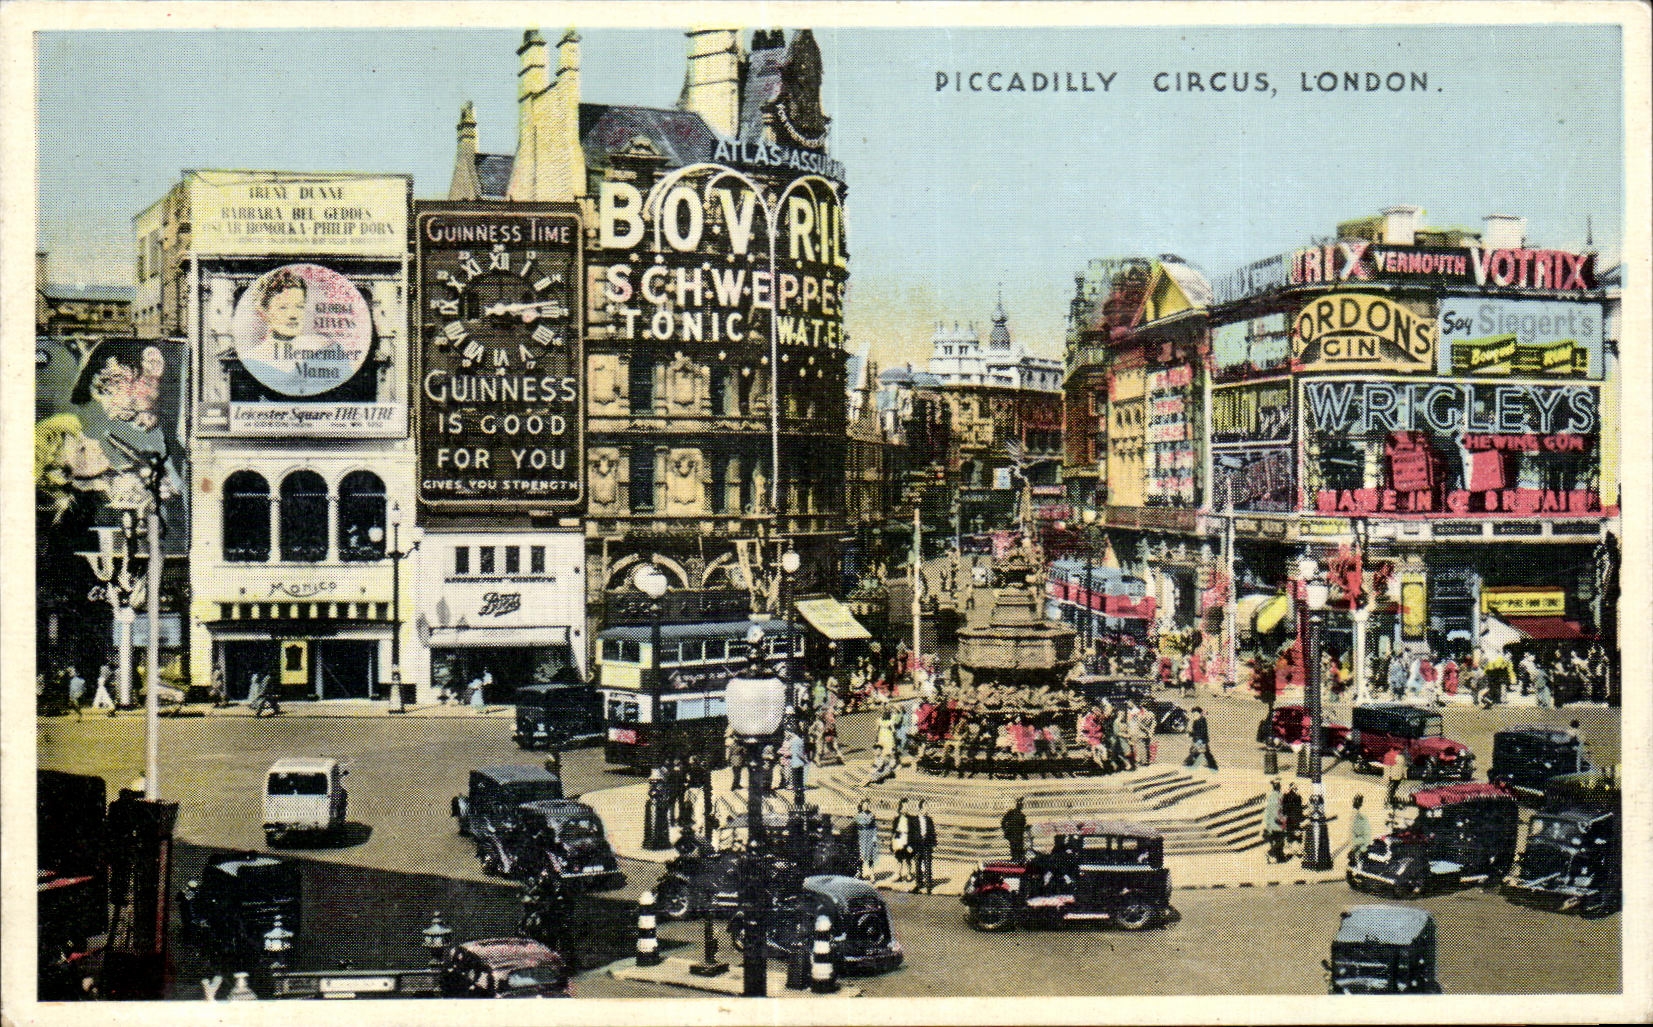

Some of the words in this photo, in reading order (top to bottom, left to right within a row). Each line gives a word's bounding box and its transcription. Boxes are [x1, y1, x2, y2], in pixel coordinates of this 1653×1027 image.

[714, 139, 782, 166] ATLAS
[249, 186, 288, 200] IRENE
[300, 186, 343, 200] DUNNE
[221, 207, 283, 221] BARBARA
[292, 207, 315, 221] BEL
[324, 207, 372, 221] GEDDES
[600, 181, 847, 269] BOVRIL
[426, 216, 522, 243] GUINNESS
[526, 217, 570, 244] TIME
[1373, 249, 1467, 276] VERMOUTH
[1469, 246, 1589, 290] VOTRIX
[605, 263, 846, 317] SCHWEPPES
[313, 317, 357, 329] STEVENS
[619, 308, 744, 342] TONIC
[1442, 310, 1473, 335] Soy
[1478, 303, 1594, 344] Siegert's
[272, 343, 279, 360] I
[284, 343, 362, 360] Remember
[1322, 337, 1377, 357] GIN
[296, 362, 340, 379] Mama
[424, 369, 577, 402] GUINNESS
[234, 407, 288, 421] Leicester
[290, 407, 333, 423] Square
[334, 407, 396, 420] THEATRE
[438, 412, 463, 435] IS
[480, 414, 566, 436] GOOD
[437, 448, 490, 469] FOR
[511, 448, 566, 470] YOU
[422, 479, 463, 490] GIVES
[468, 479, 497, 490] YOU
[503, 479, 579, 490] STRENGTH
[1408, 489, 1432, 512] IN
[267, 581, 338, 598] Monico
